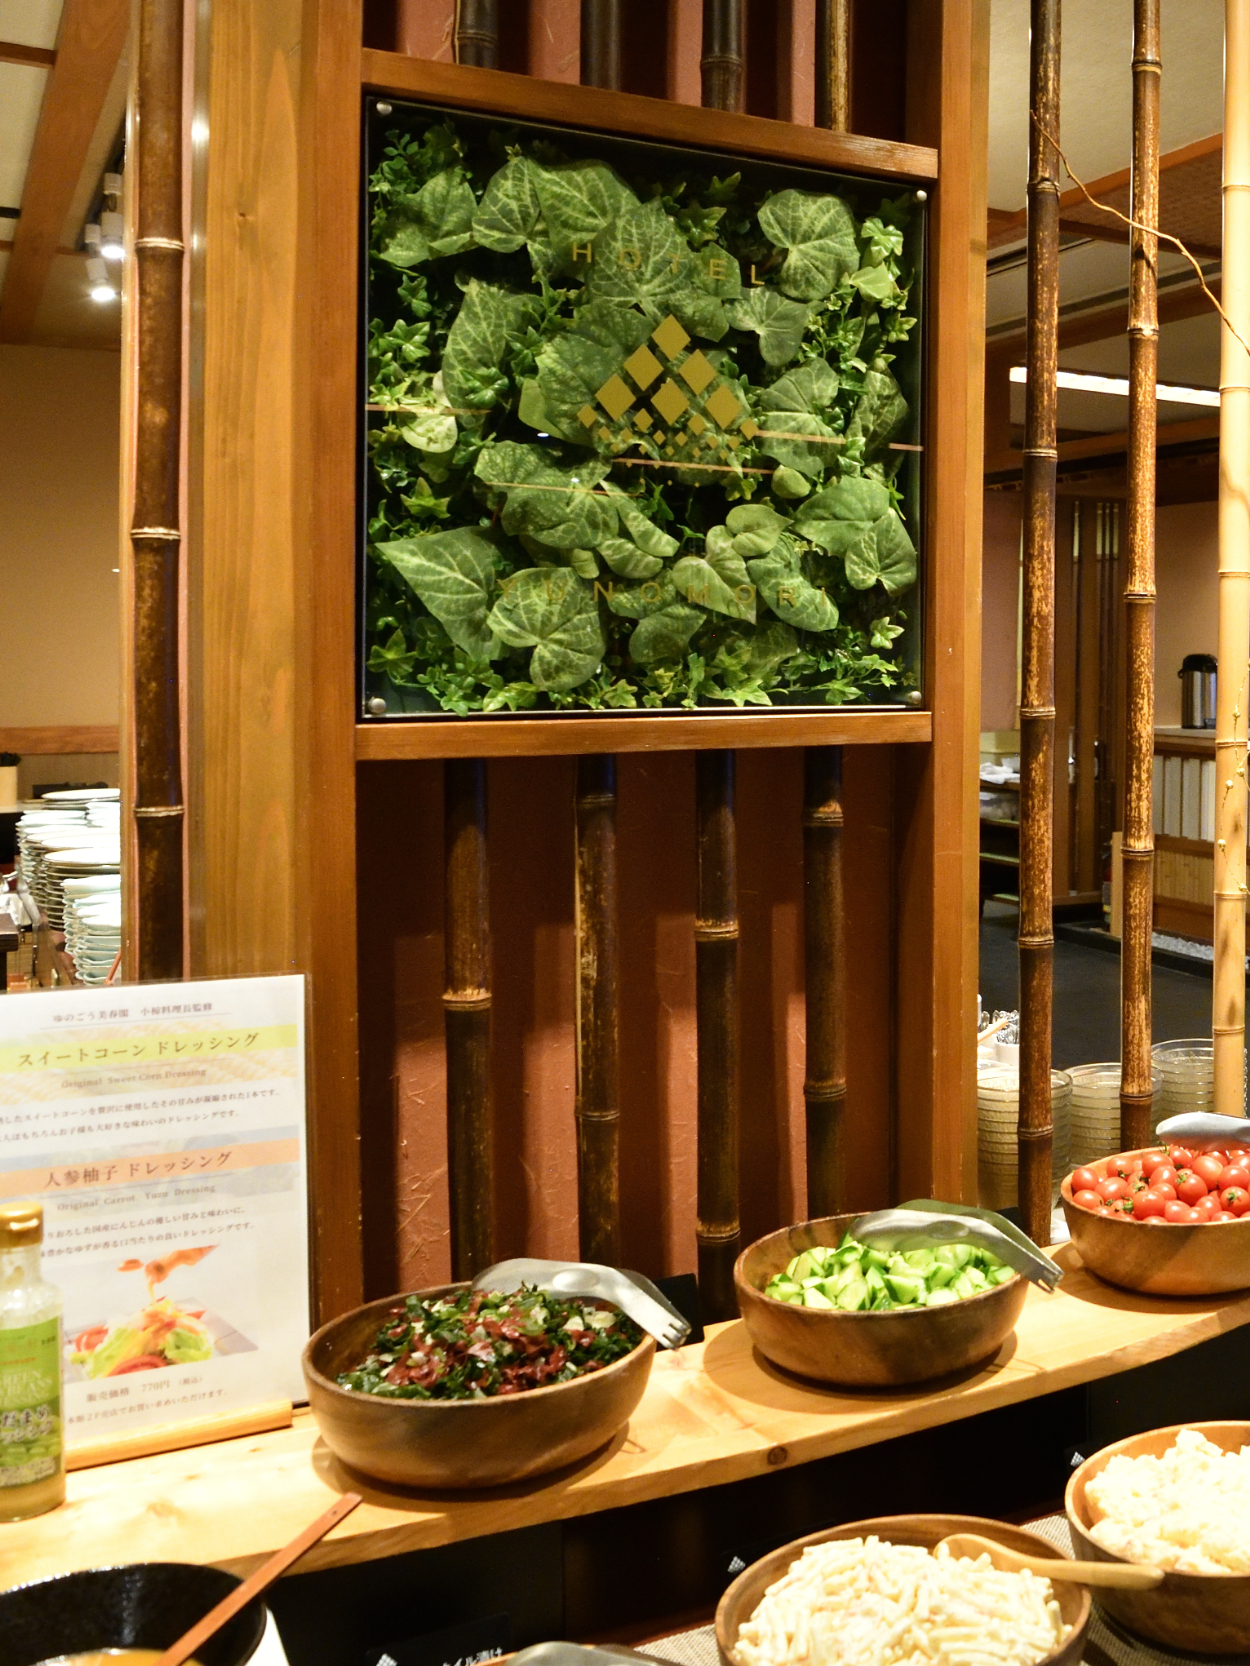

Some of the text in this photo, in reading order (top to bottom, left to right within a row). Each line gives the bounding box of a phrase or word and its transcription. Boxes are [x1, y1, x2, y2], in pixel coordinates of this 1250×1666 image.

[572, 242, 765, 286] HOTEL
[497, 579, 826, 606] YUNOMORI
[17, 1032, 259, 1067] スイートコーン ドレッシング
[61, 1069, 206, 1089] Original Sweet Corn Dressing
[44, 1151, 232, 1189] 人参柚子 ドレッシング
[57, 1185, 216, 1211] Original Carrot Yuzu Dressing
[86, 1387, 130, 1402] 販売価格
[141, 1379, 170, 1393] 770円
